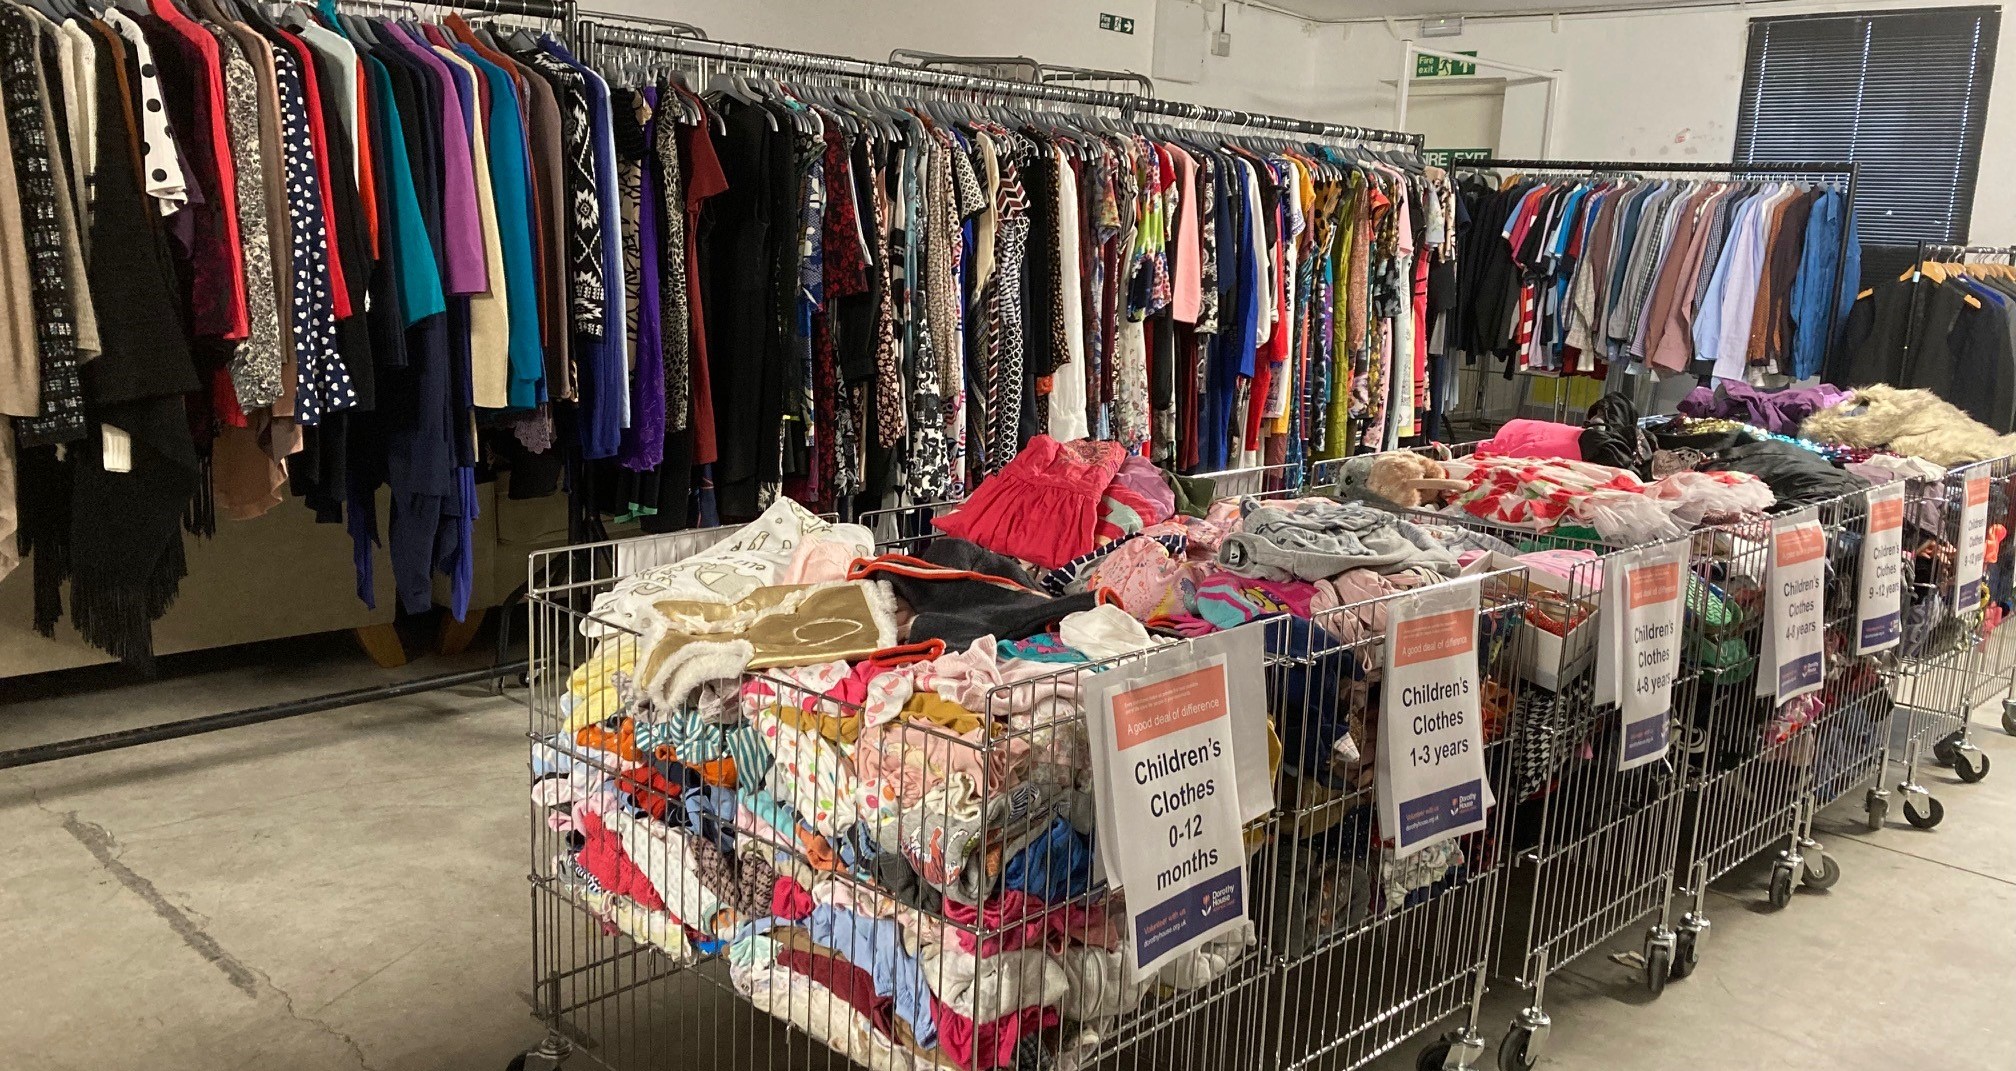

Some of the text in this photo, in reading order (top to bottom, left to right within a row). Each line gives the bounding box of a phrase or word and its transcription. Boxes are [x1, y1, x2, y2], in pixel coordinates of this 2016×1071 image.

[1419, 56, 1434, 65] Fire
[1874, 542, 1900, 560] Children's
[1876, 564, 1896, 578] Clothes
[1784, 576, 1820, 596] Children's
[1886, 582, 1900, 598] years
[1788, 600, 1814, 618] Clothes
[1634, 620, 1674, 644] Children's
[1796, 622, 1816, 640] years
[1406, 643, 1422, 657] good
[1422, 640, 1436, 652] deal
[1638, 648, 1670, 668] Clothes
[1402, 676, 1469, 708] Children's
[1636, 672, 1670, 694] 4-8 years
[1128, 724, 1134, 736] A
[1134, 718, 1152, 736] good
[1154, 714, 1172, 726] deal
[1172, 708, 1180, 720] of
[1181, 698, 1220, 718] difference
[1413, 710, 1464, 736] Clothes
[1134, 738, 1222, 785] Children's
[1410, 738, 1468, 767] 1-3 years
[1150, 779, 1215, 818] Clothes
[1169, 814, 1203, 848] 0-12
[1157, 848, 1218, 891] months
[1212, 884, 1234, 900] Dorothy
[1212, 894, 1230, 908] House
